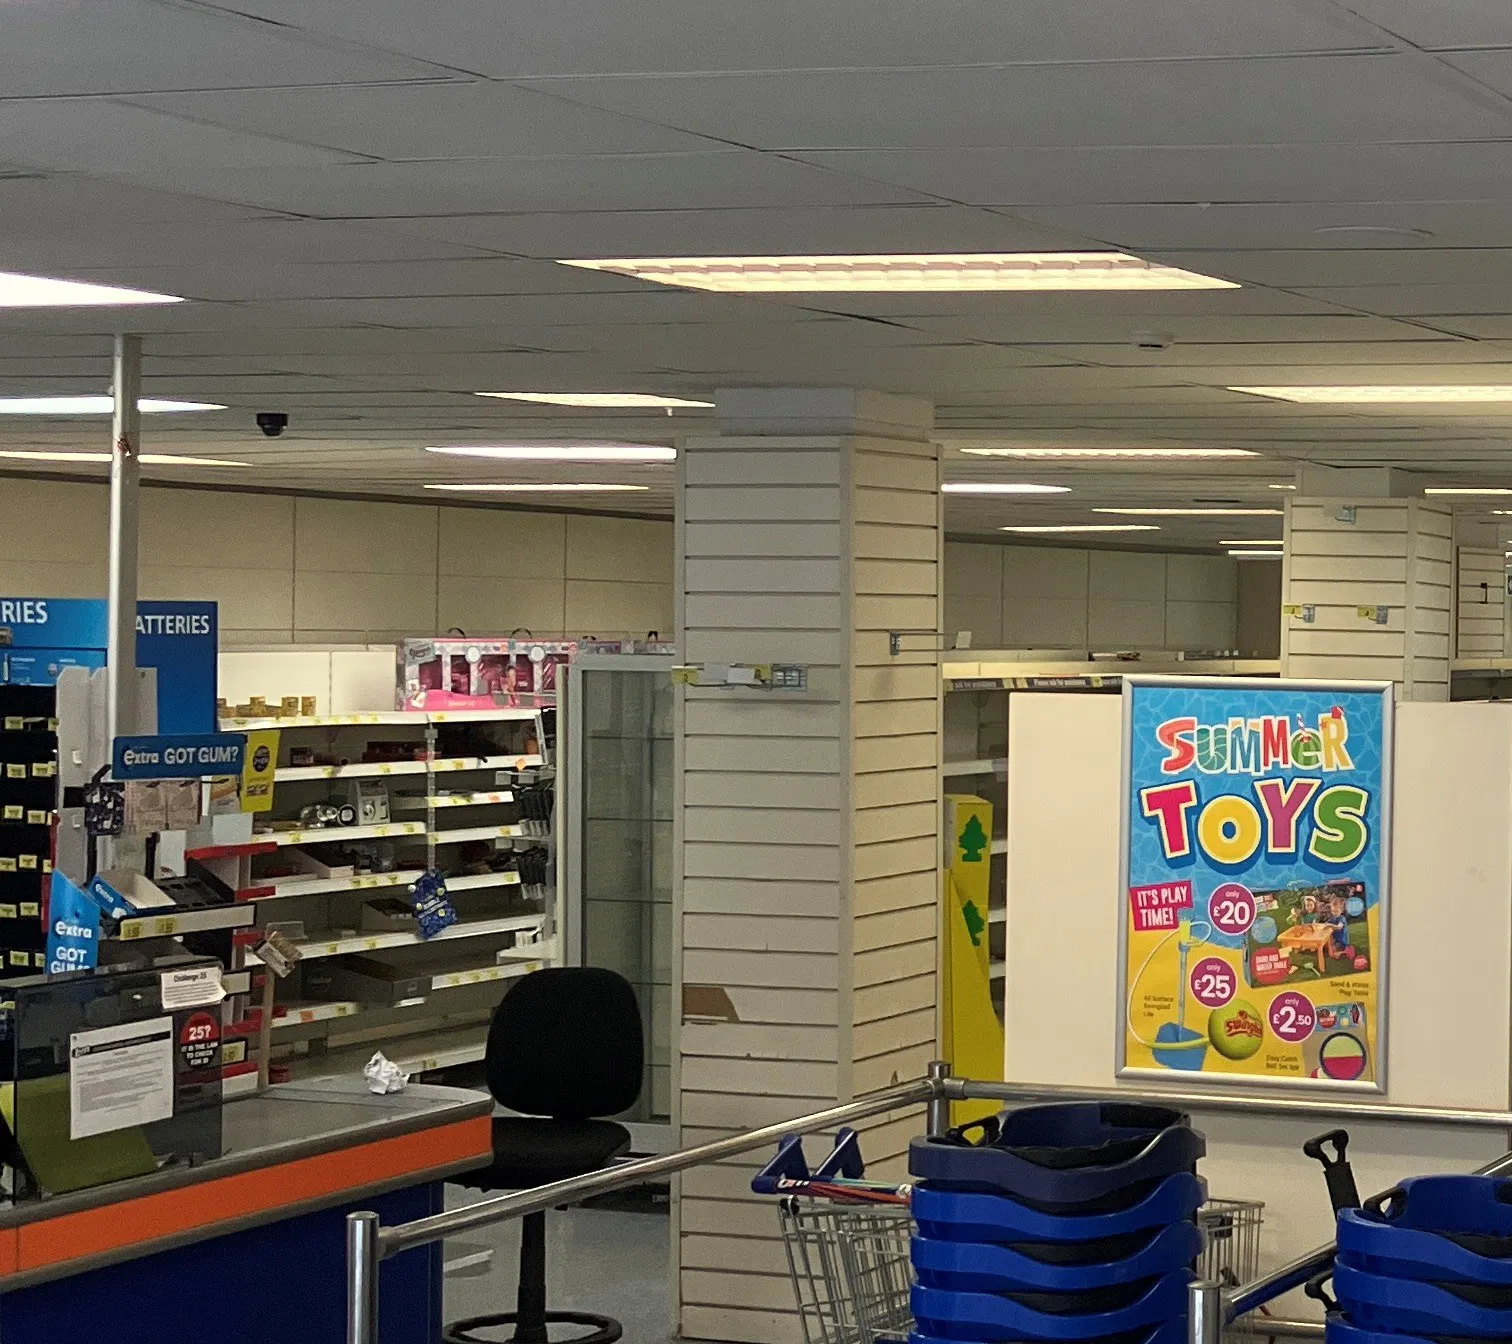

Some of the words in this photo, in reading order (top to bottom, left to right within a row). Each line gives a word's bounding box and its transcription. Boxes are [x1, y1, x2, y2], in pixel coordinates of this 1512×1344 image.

[136, 614, 210, 635] ATTERIES
[123, 749, 160, 766] extra
[164, 748, 197, 765] GOT
[198, 746, 239, 764] GUM?
[1141, 777, 1371, 870] TOYS
[1137, 889, 1159, 908] IT'S
[1160, 885, 1188, 905] PLAY
[1140, 907, 1174, 928] TIME!
[1213, 900, 1250, 925] £20
[54, 920, 93, 939] extra
[55, 946, 88, 962] GOT
[1194, 974, 1231, 999] £25
